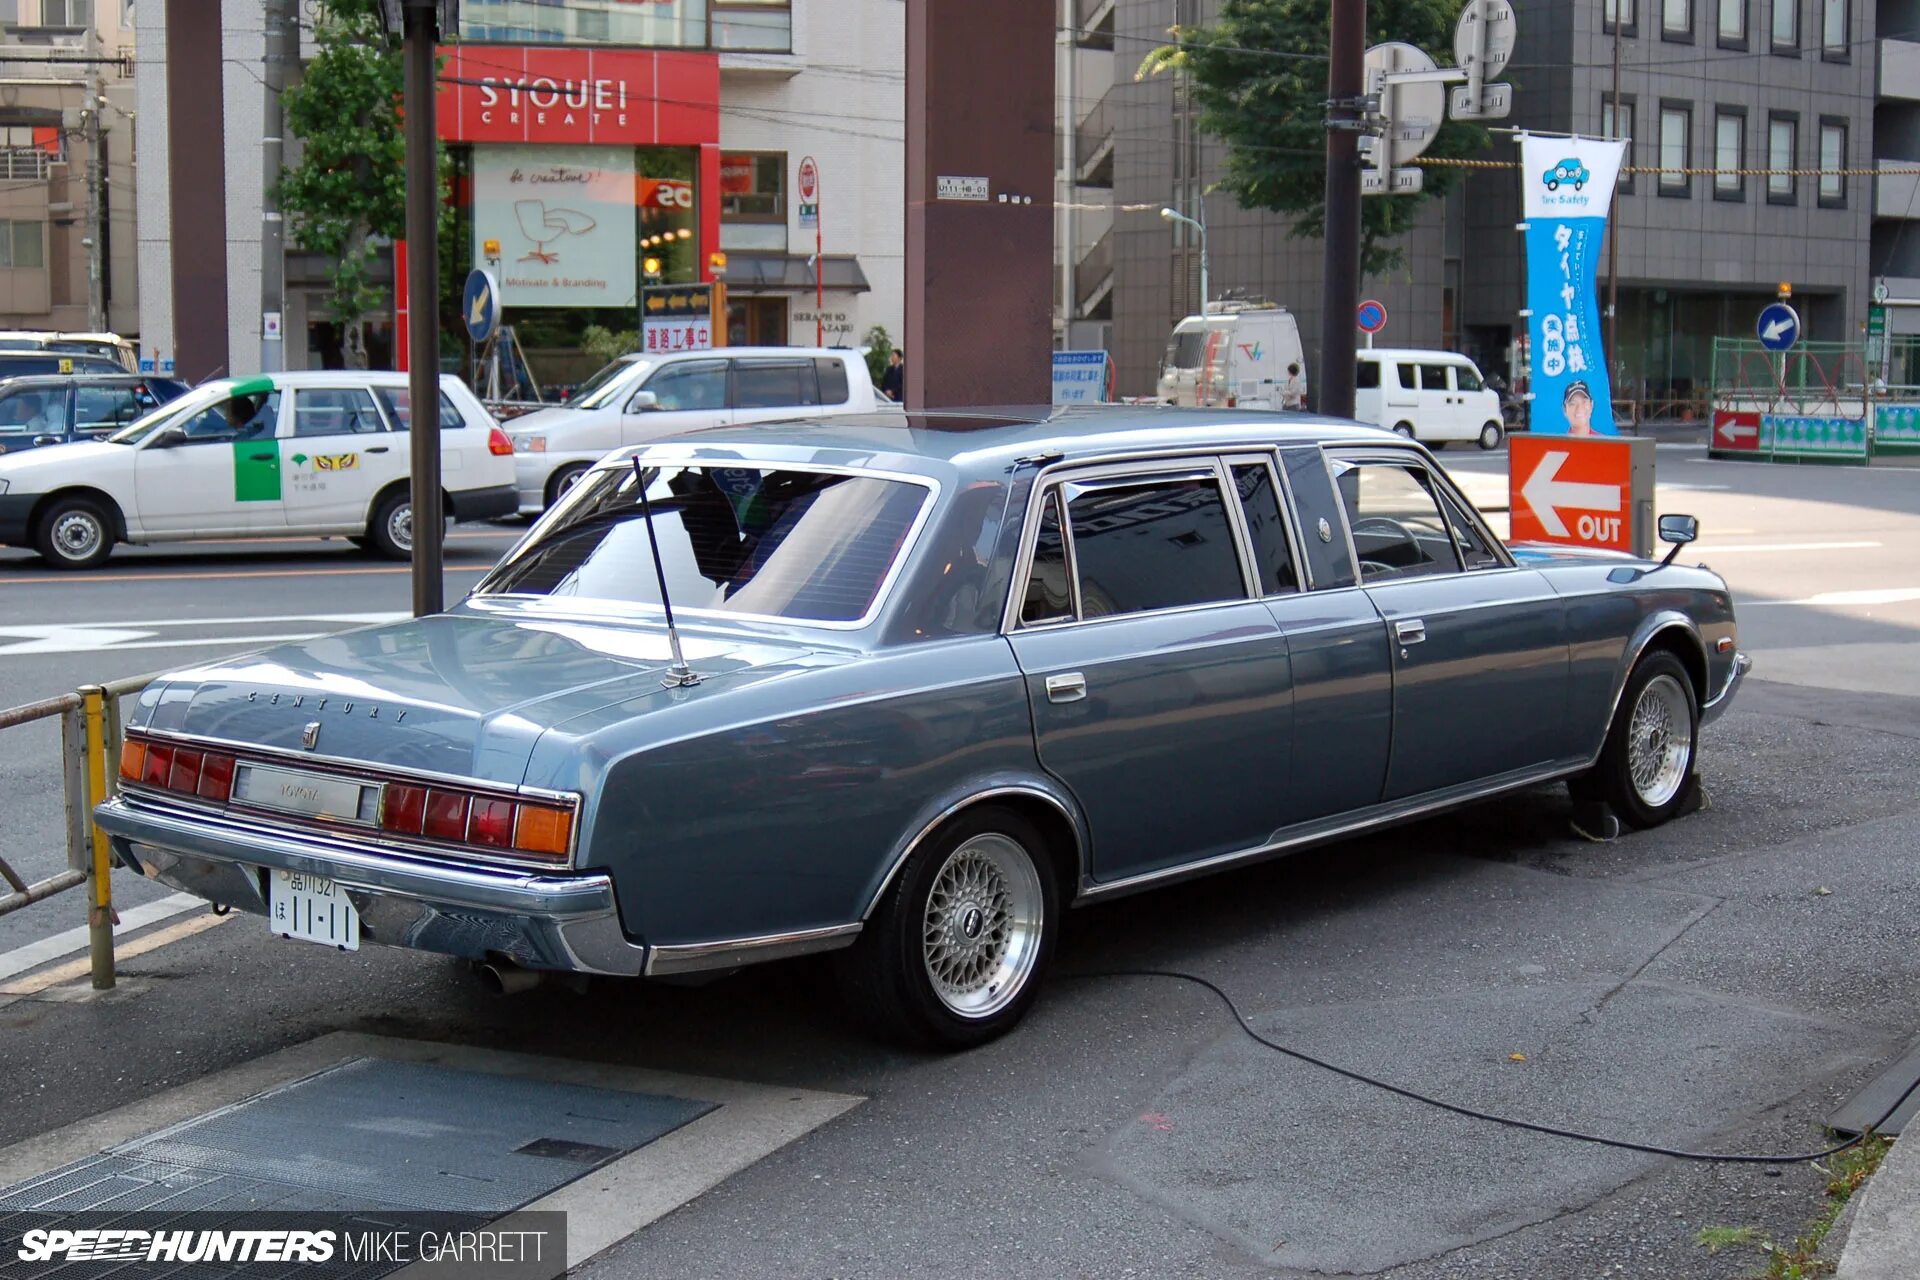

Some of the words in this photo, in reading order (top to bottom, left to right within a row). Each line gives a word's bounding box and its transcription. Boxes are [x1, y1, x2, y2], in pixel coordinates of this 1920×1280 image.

[480, 77, 626, 109] SYOUEI
[481, 111, 626, 125] CREATE
[562, 277, 607, 289] Branding
[647, 326, 708, 350] 道路工事中
[1578, 515, 1621, 542] OUT
[248, 691, 406, 723] CENTURY
[281, 783, 320, 801] TOYOTA
[275, 901, 286, 920] は
